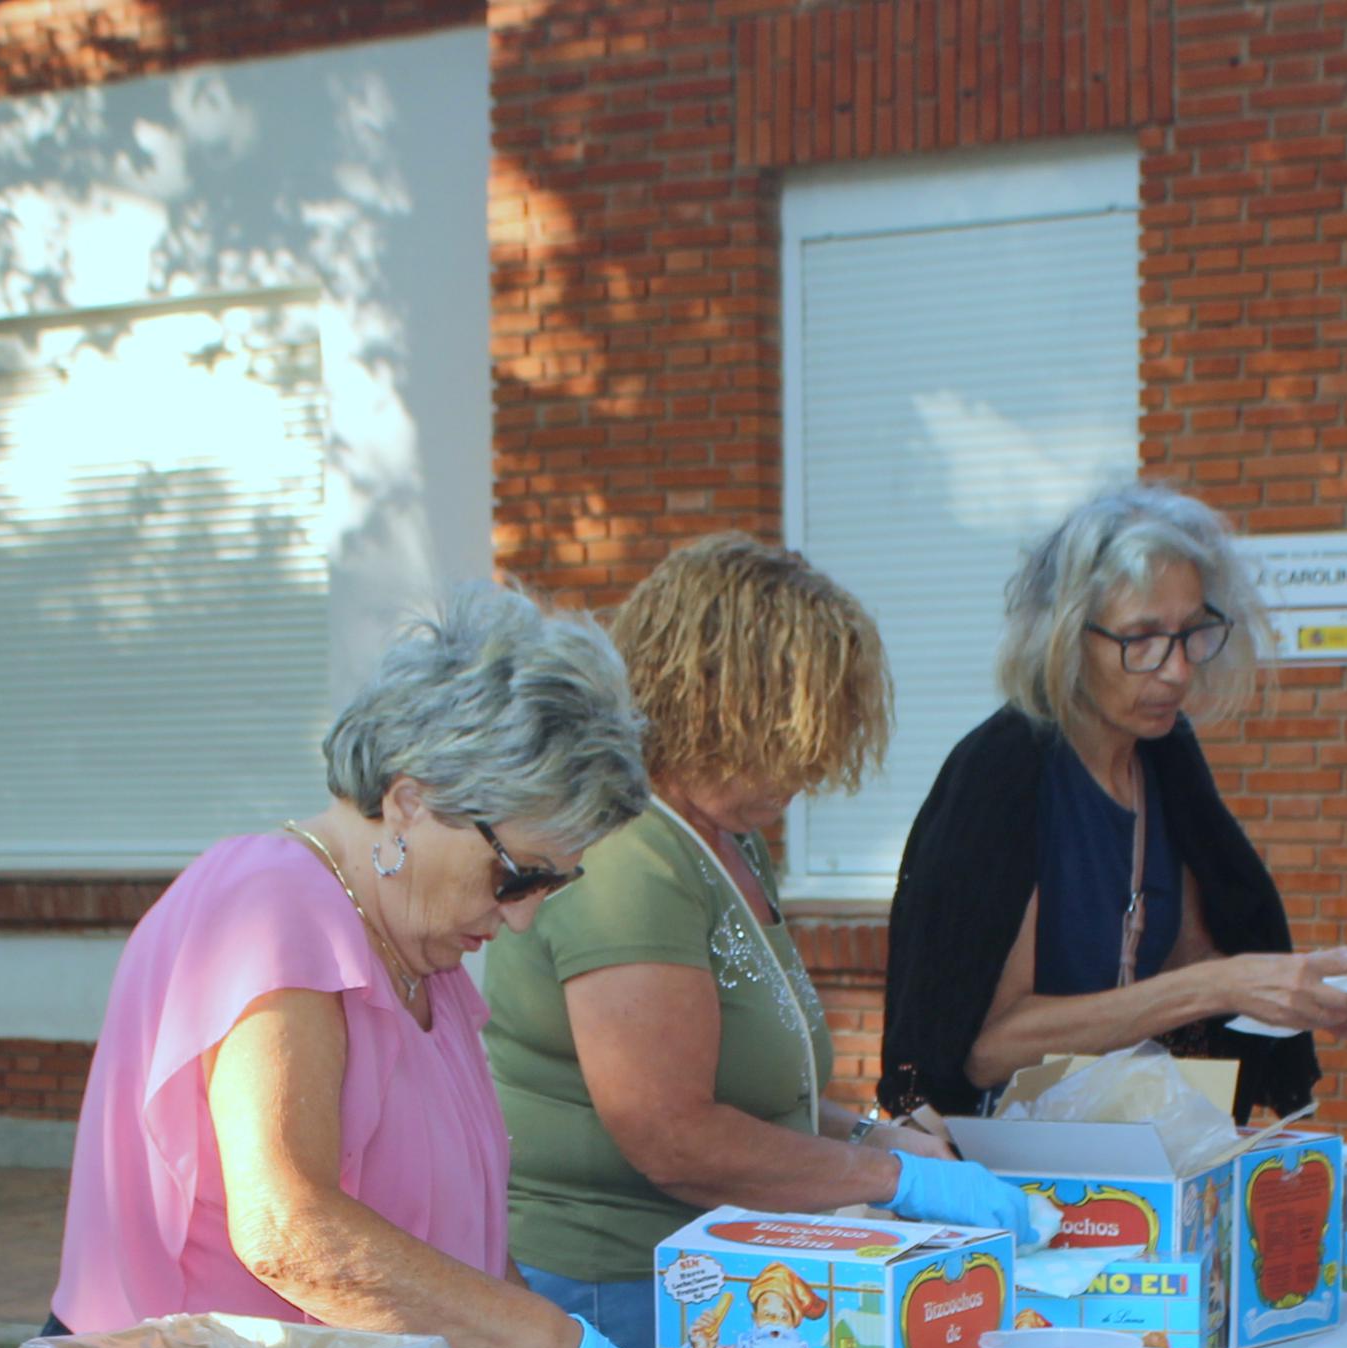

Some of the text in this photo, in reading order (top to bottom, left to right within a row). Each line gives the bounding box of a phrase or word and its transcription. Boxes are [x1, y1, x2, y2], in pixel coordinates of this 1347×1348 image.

[753, 1222, 871, 1240] Bizcochos
[1062, 1218, 1120, 1237] ochos
[748, 1234, 834, 1249] Lerma
[923, 1292, 984, 1322] Bizcochos
[946, 1324, 962, 1343] de
